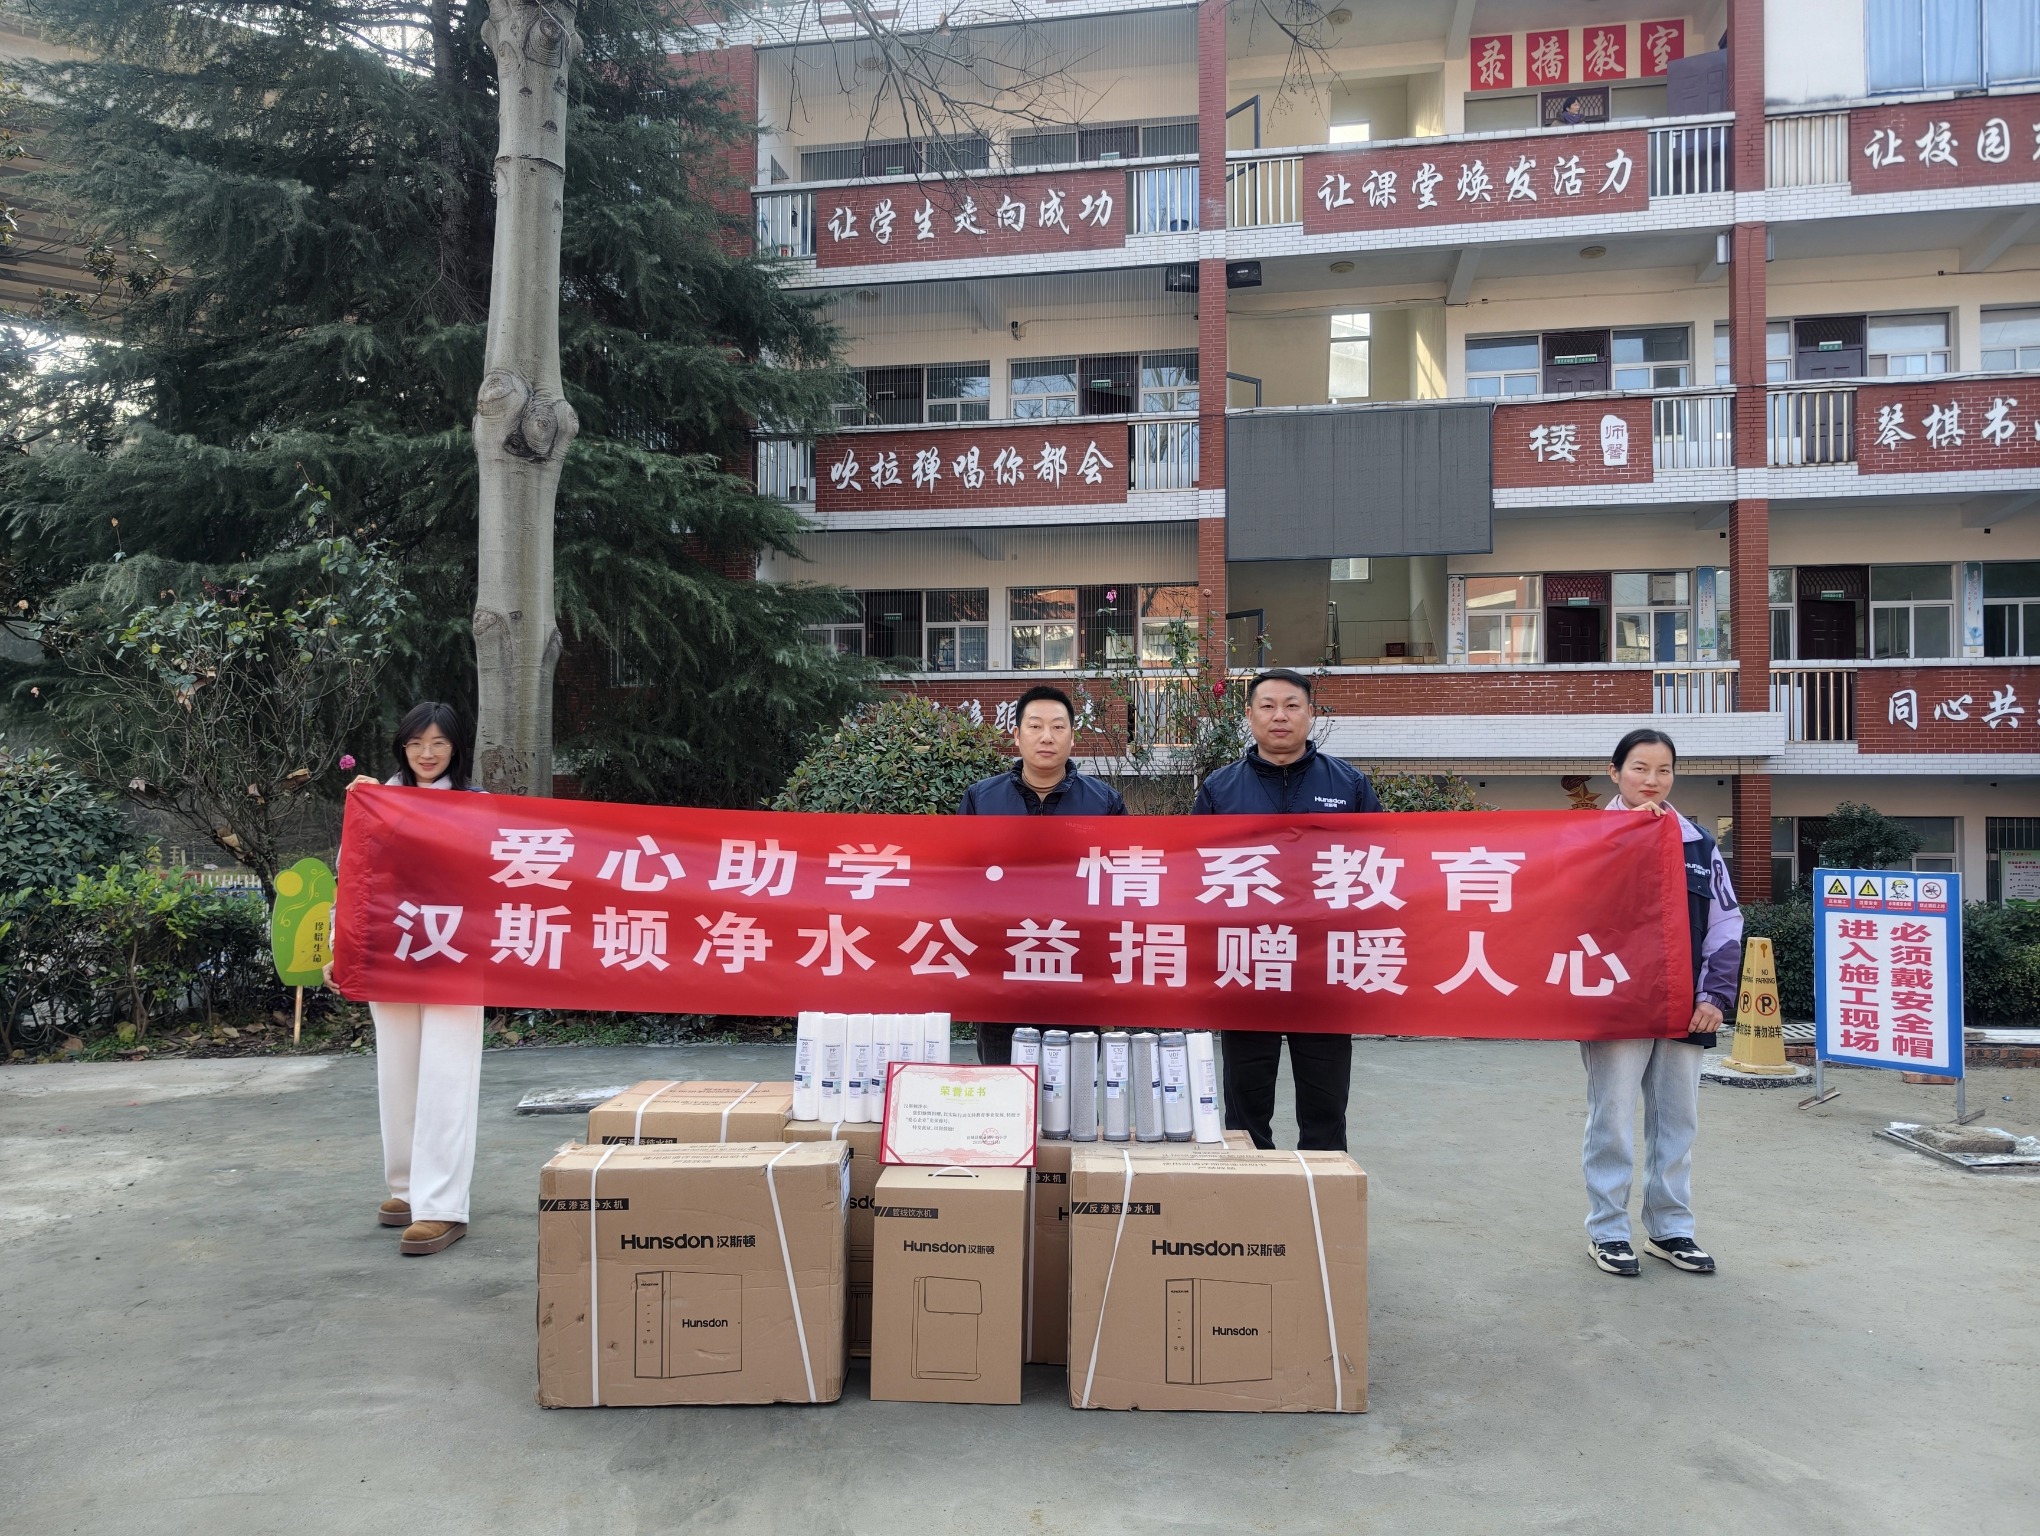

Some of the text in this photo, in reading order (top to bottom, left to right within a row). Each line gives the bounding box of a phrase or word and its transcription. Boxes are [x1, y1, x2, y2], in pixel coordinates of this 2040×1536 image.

[1476, 25, 1680, 87] 录播教室
[1864, 117, 2040, 169] 让校园
[1317, 148, 1633, 211] 让课堂焕发活力
[828, 189, 1114, 245] 让学生走向成功
[1528, 423, 1581, 463] 楼
[1873, 397, 2040, 450] 琴棋书
[830, 440, 1114, 493] 吹拉弹唱你都会
[1888, 684, 2040, 731] 同心共
[393, 900, 1631, 997] 汉斯顿净水公益捐赠暖人心
[1755, 977, 1775, 985] PARKING
[1761, 968, 1769, 976] NO
[1839, 919, 1880, 1053] 进入施工现场
[1890, 922, 1934, 1060] 必须戴安全帽
[1754, 1025, 1782, 1038] 请勿泊车
[940, 1085, 987, 1097] 荣誉证书
[892, 1208, 932, 1218] 管线饮水机
[621, 1233, 756, 1250] Hunsdon 汉斯顿
[904, 1240, 995, 1254] Hunsdon 汉斯顿
[1152, 1240, 1286, 1256] Hunsdon 汉斯顿
[682, 1318, 728, 1328] Hunsdon
[1212, 1326, 1258, 1336] Hunsdon
